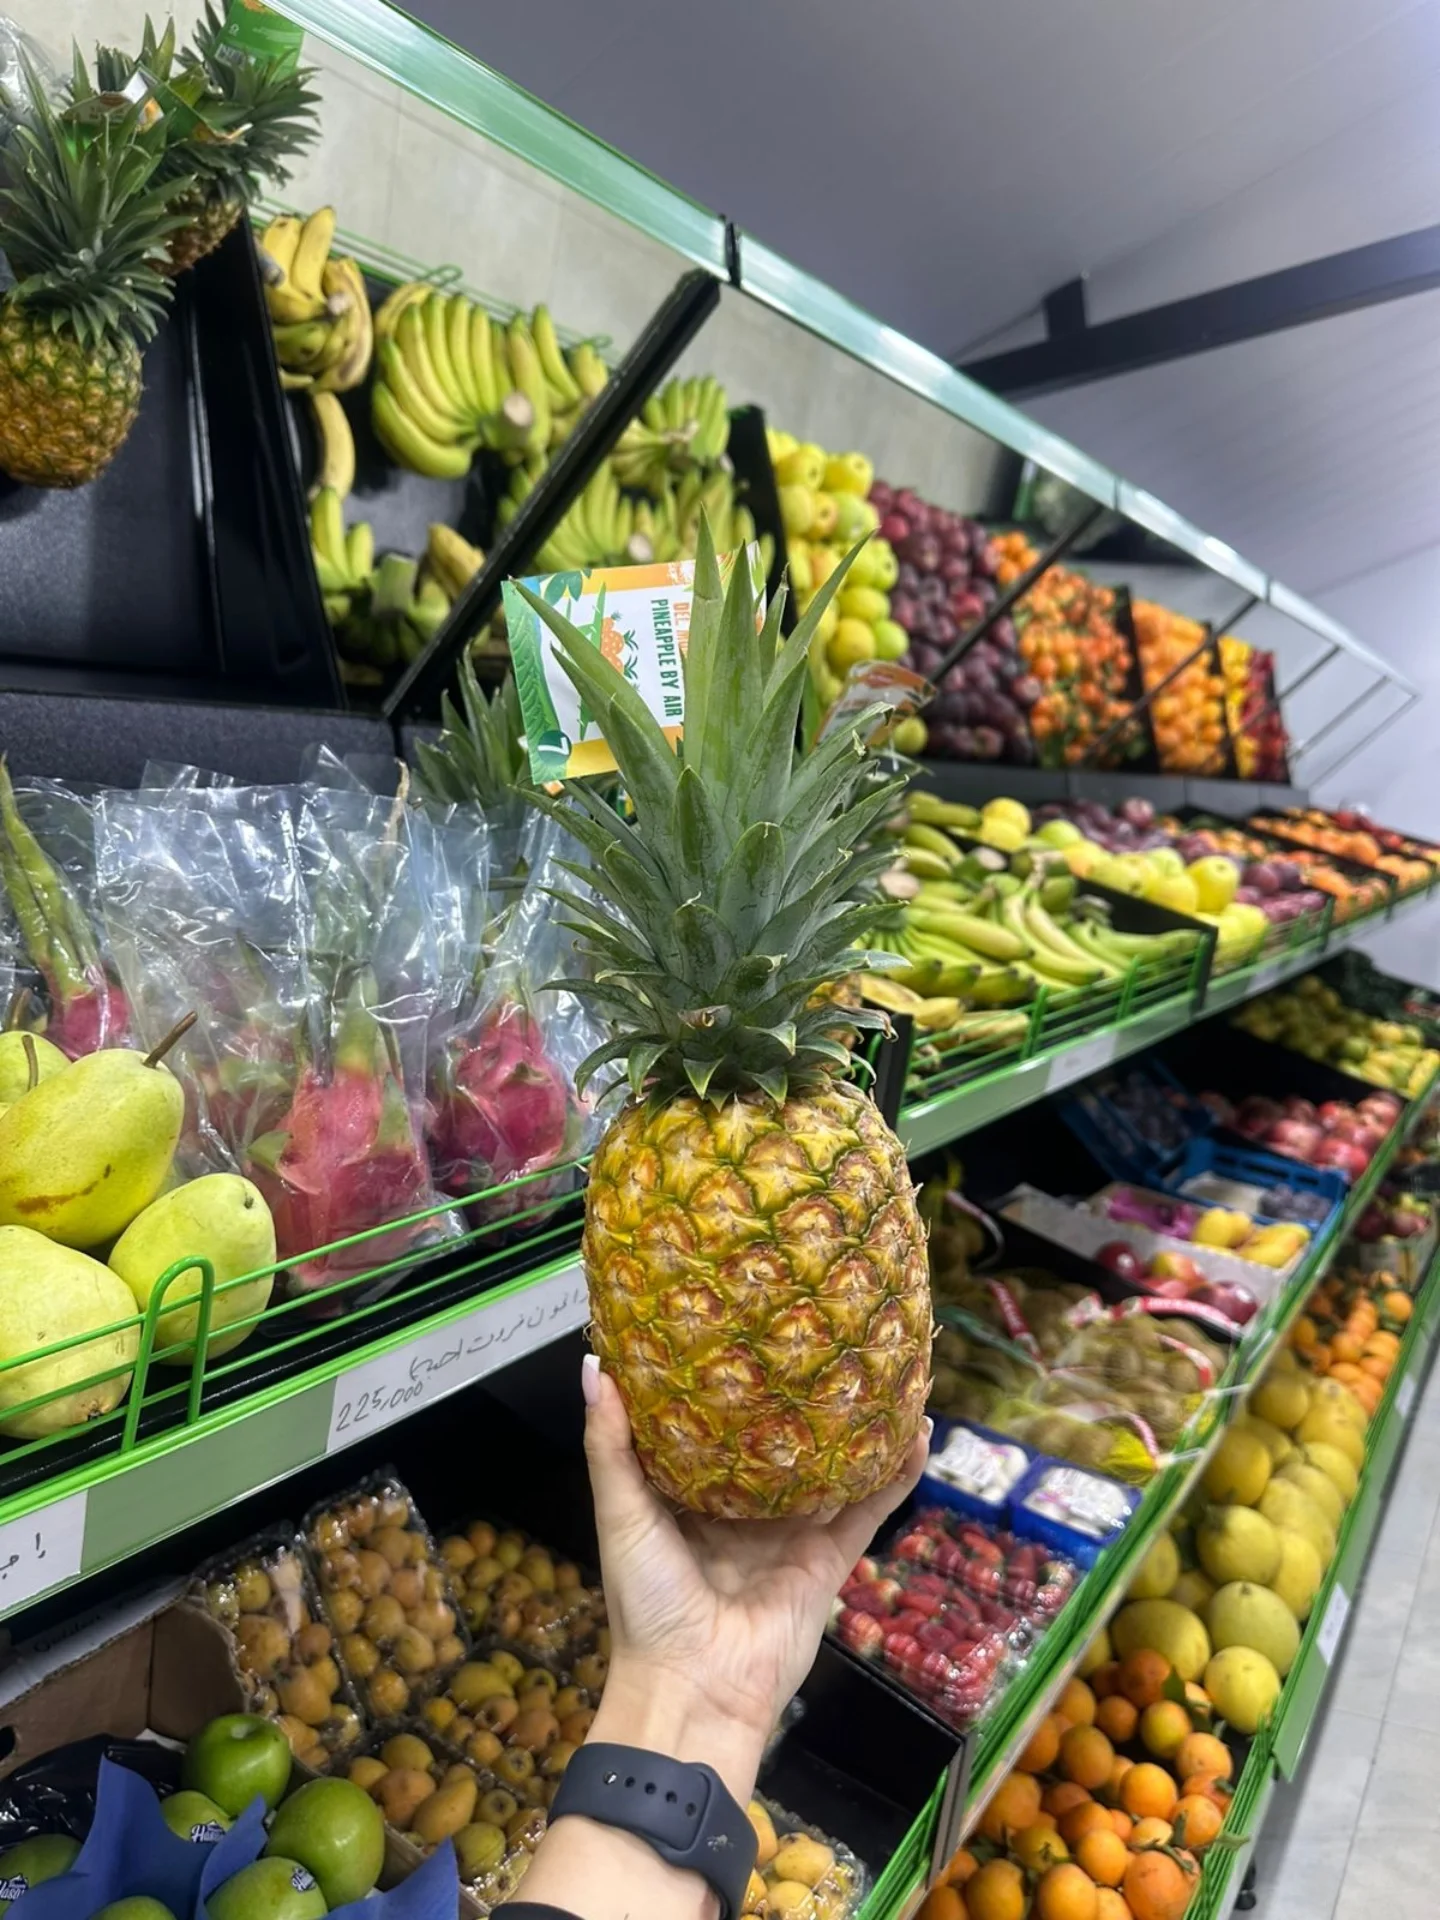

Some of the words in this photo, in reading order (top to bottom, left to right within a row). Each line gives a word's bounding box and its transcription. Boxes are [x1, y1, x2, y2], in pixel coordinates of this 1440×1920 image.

[651, 598, 677, 666] PINEAPPLE
[660, 670, 680, 690] BY
[663, 695, 683, 717] AIR
[335, 1379, 423, 1432] 225,000
